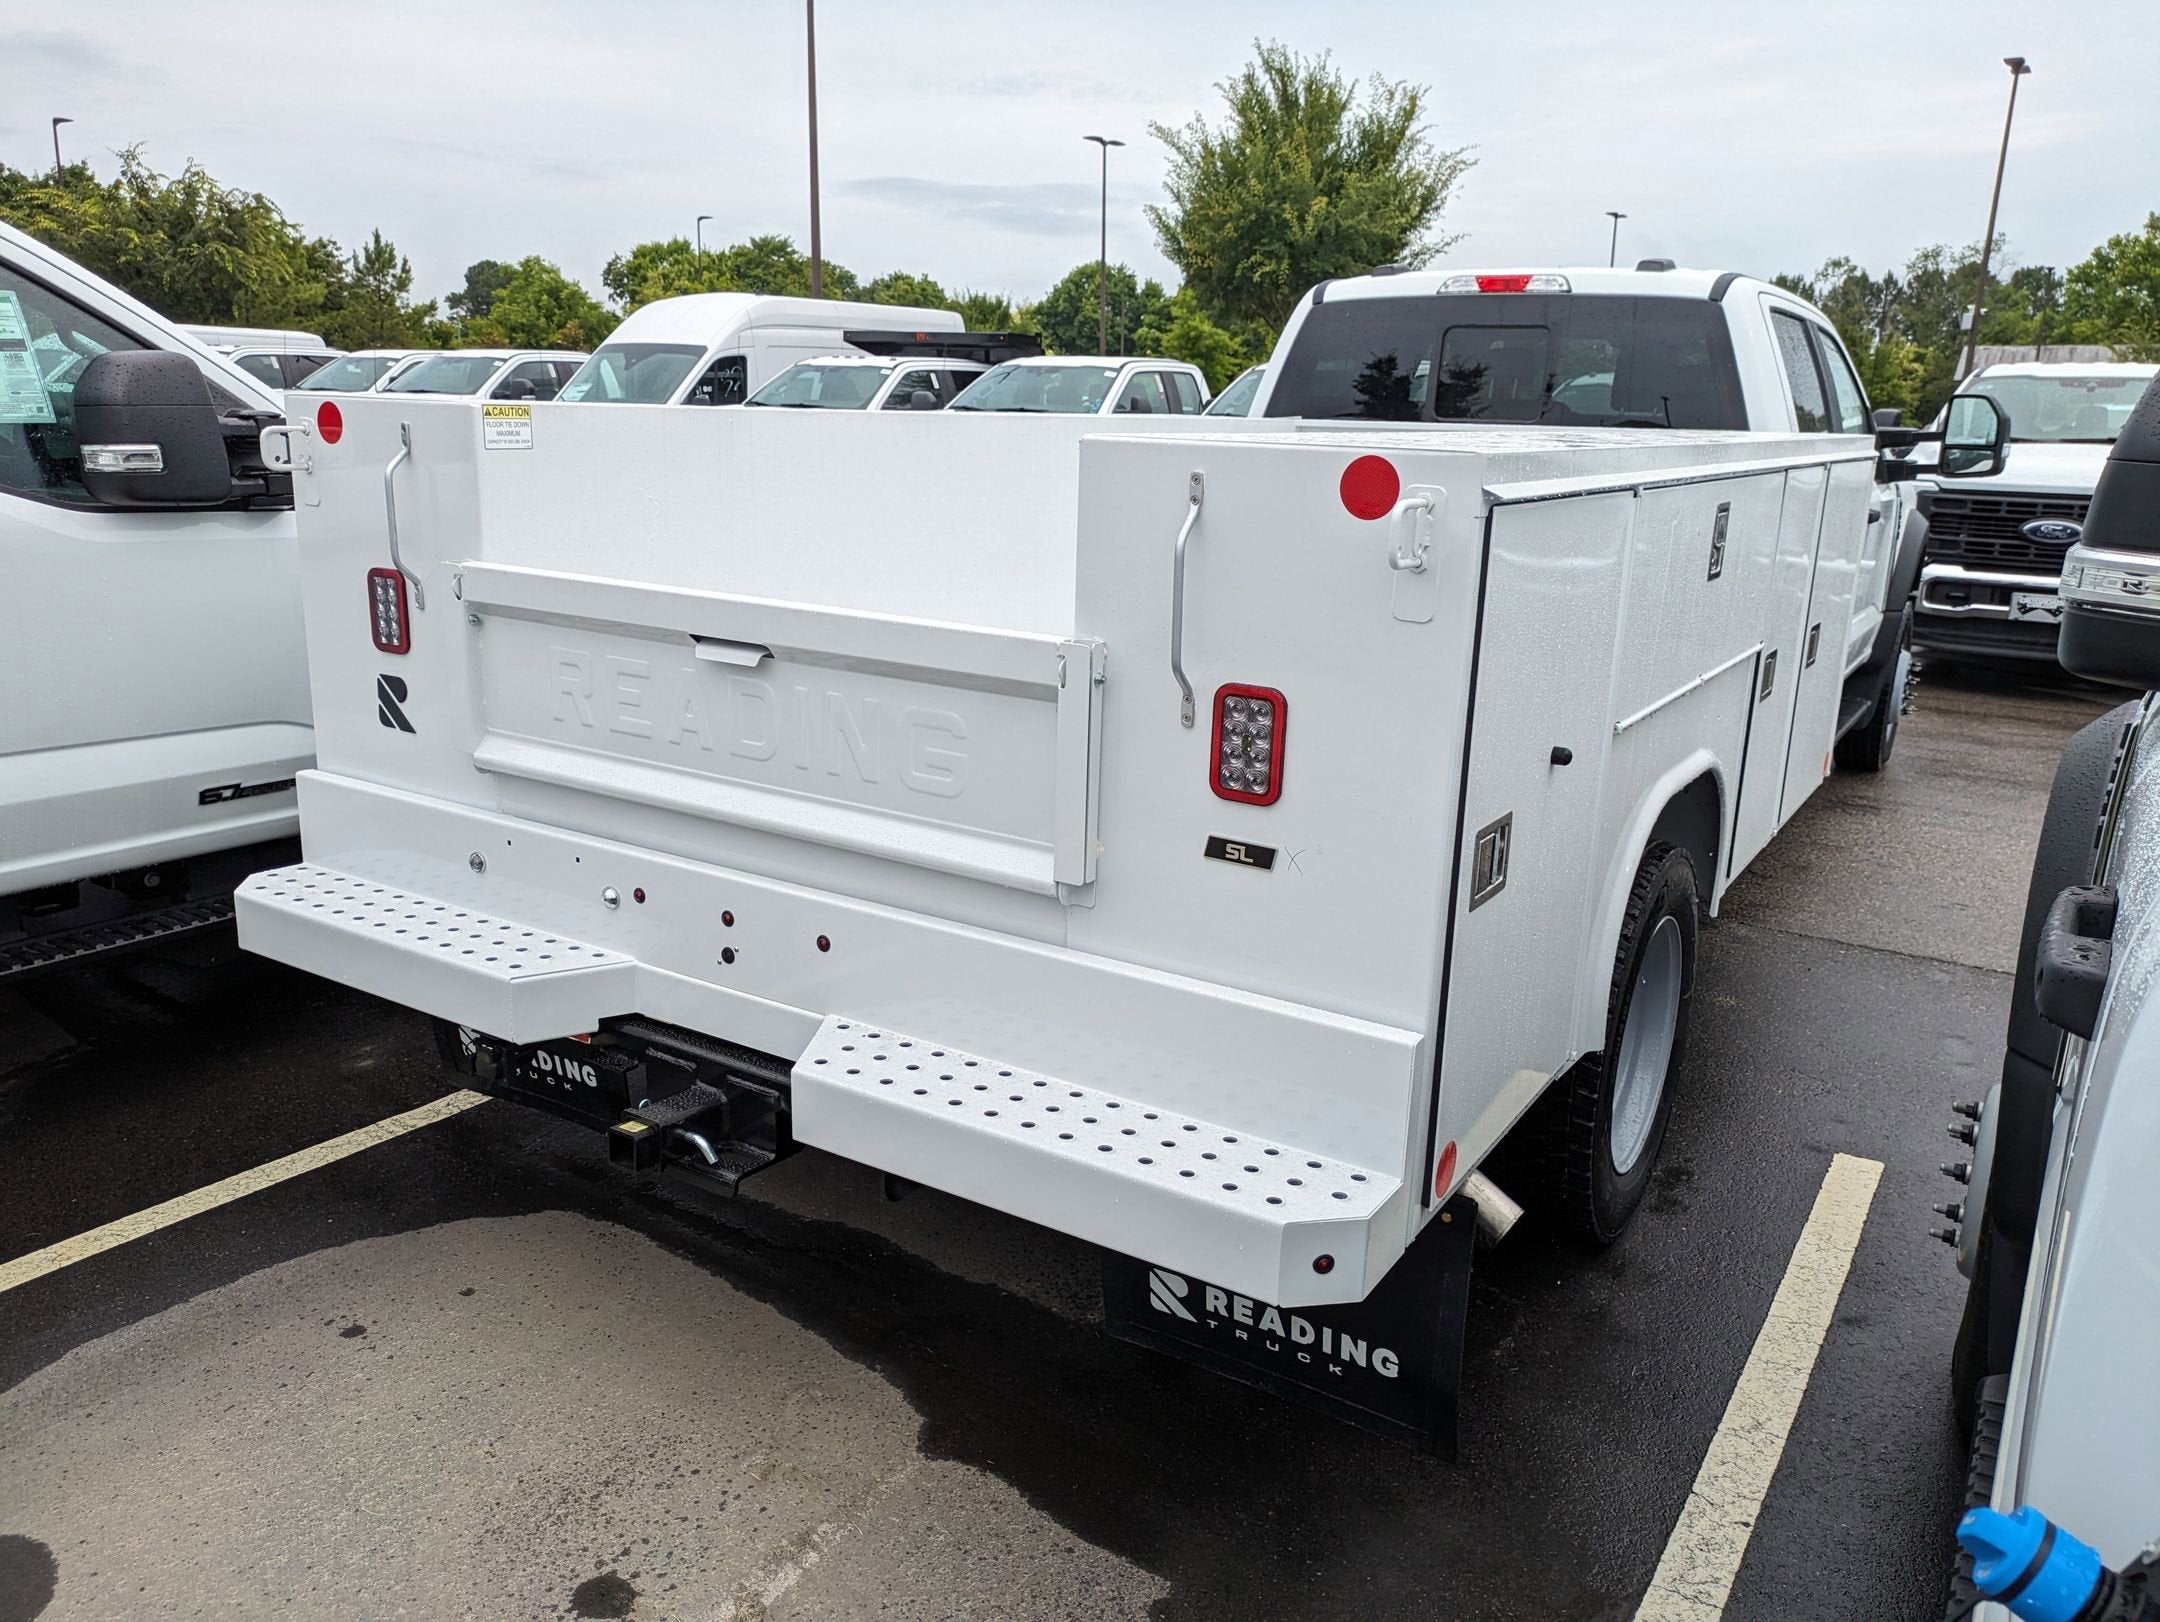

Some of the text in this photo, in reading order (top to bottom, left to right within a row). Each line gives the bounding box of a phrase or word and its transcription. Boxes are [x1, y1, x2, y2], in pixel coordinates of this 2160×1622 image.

[492, 406, 530, 417] CAUTION
[549, 645, 968, 799] READING
[1225, 843, 1254, 863] SL
[531, 1050, 598, 1087] DING
[1205, 1285, 1399, 1378] READING
[1206, 1319, 1343, 1376] TRUCK
